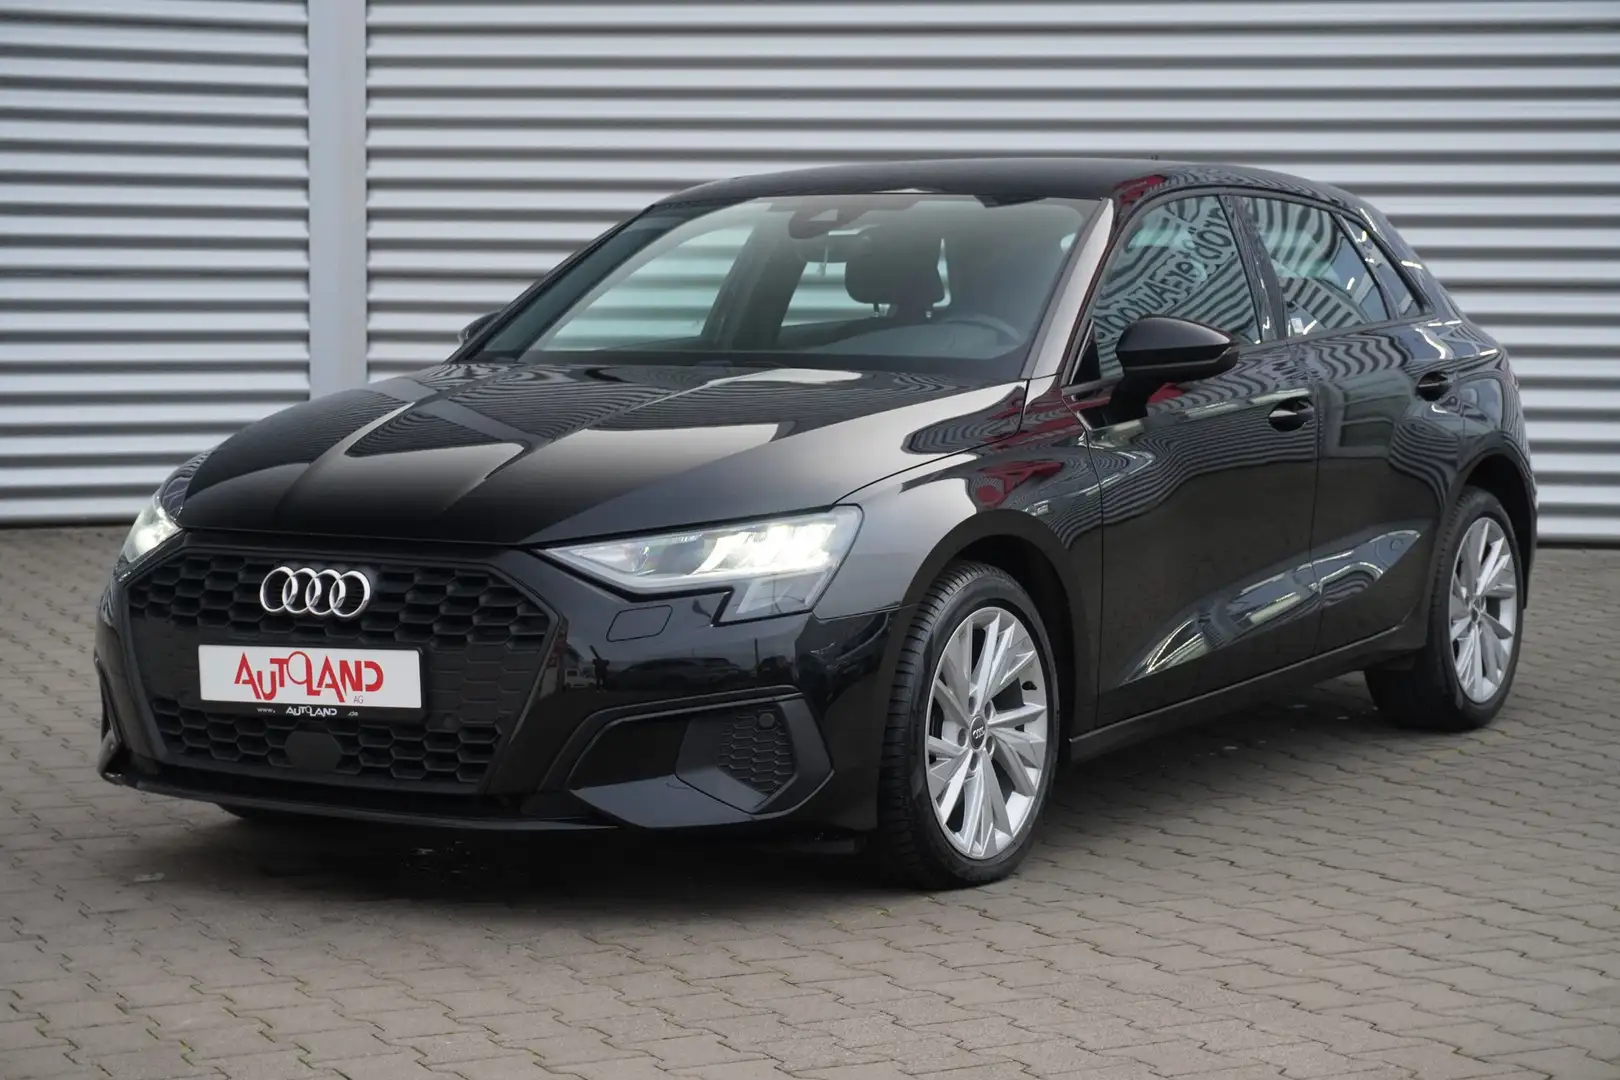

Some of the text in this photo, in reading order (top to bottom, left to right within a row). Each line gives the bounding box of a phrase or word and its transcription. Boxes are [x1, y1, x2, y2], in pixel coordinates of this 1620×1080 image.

[234, 651, 384, 703] AUTOLAND
[353, 695, 364, 705] AG
[285, 705, 338, 717] AUTOLAND
